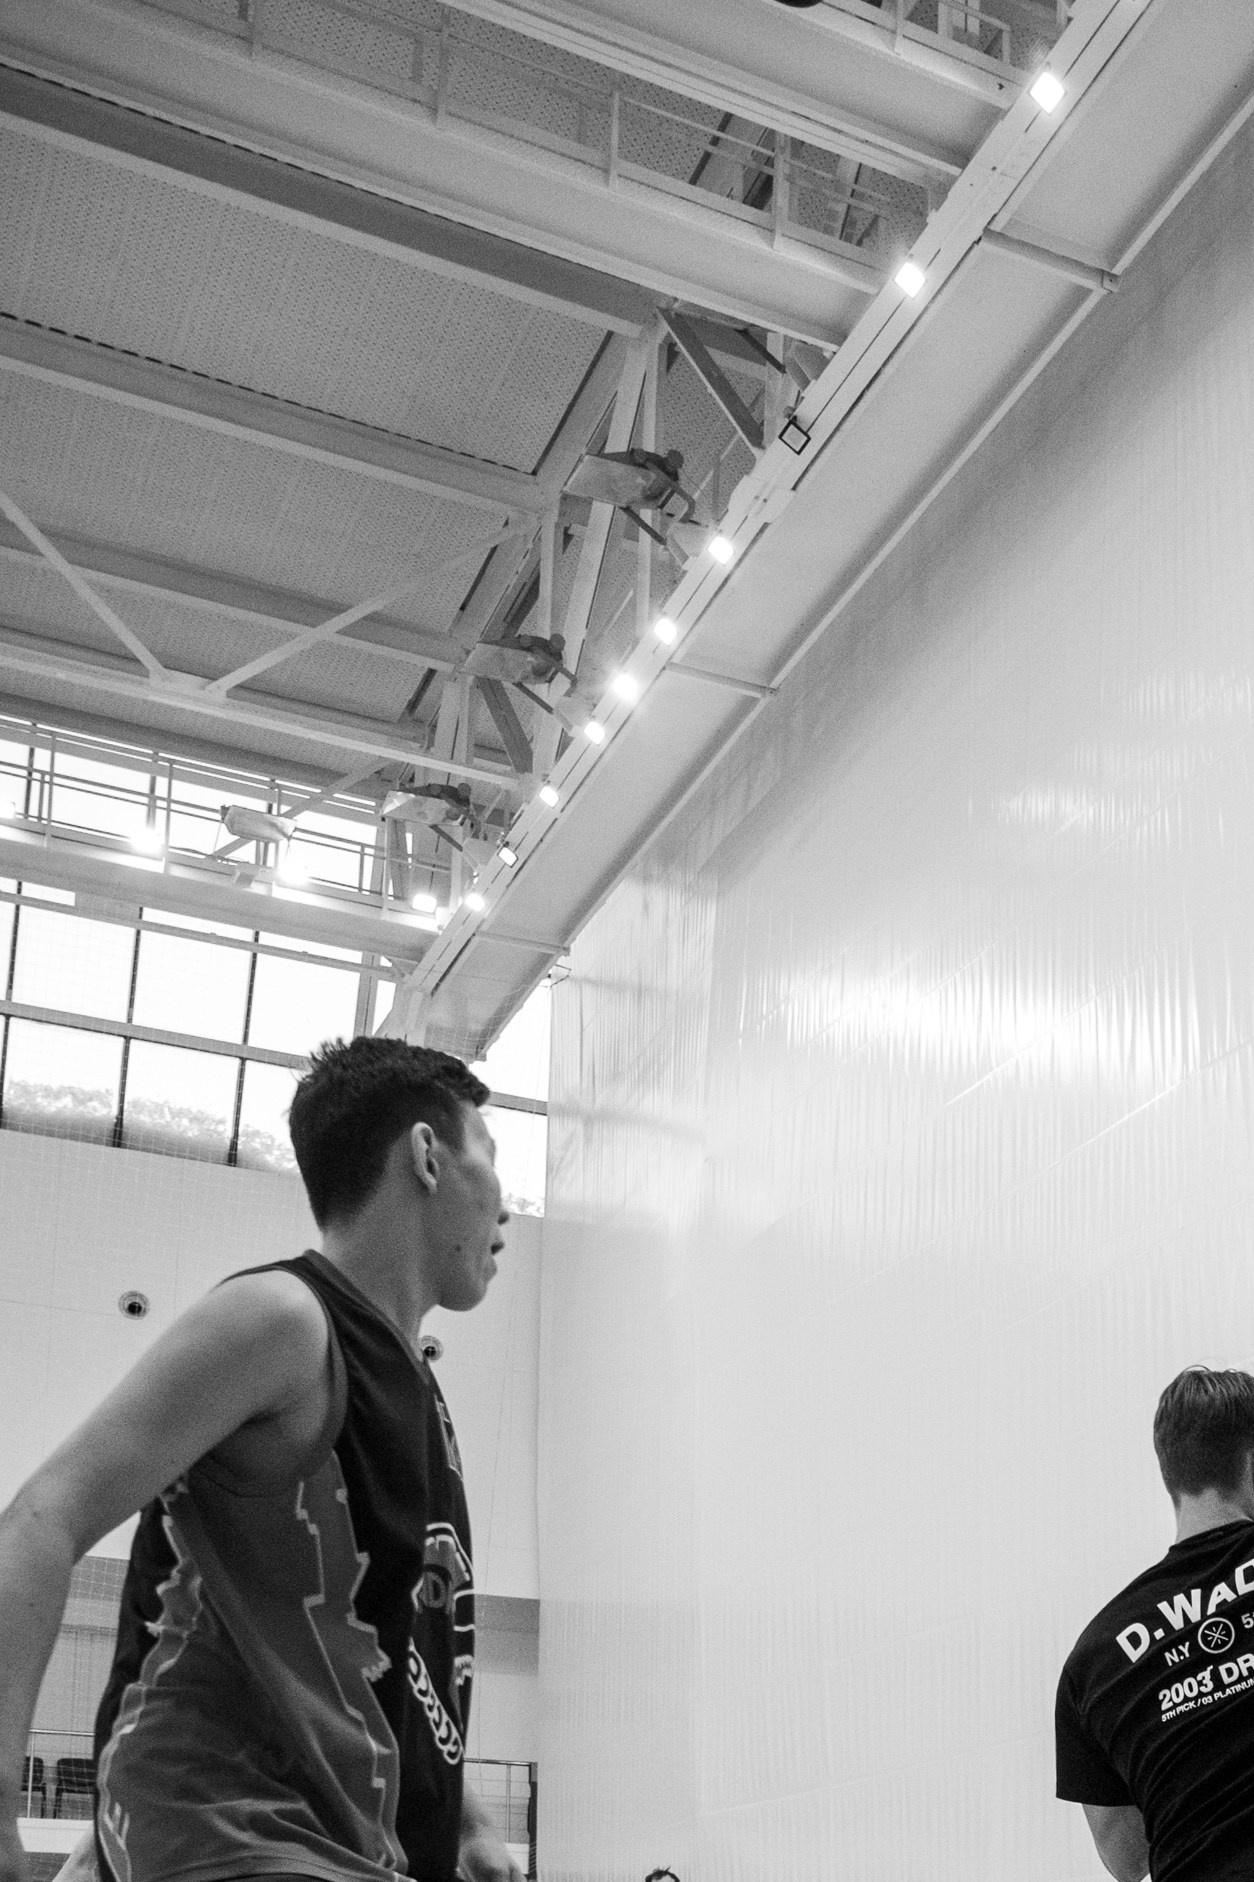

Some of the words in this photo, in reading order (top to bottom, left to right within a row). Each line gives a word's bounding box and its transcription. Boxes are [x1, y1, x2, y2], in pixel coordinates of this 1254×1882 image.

[1164, 1641, 1191, 1667] N.Y
[1161, 1710, 1176, 1722] 5TH
[1176, 1700, 1197, 1716] PICK
[1201, 1696, 1213, 1706] 03
